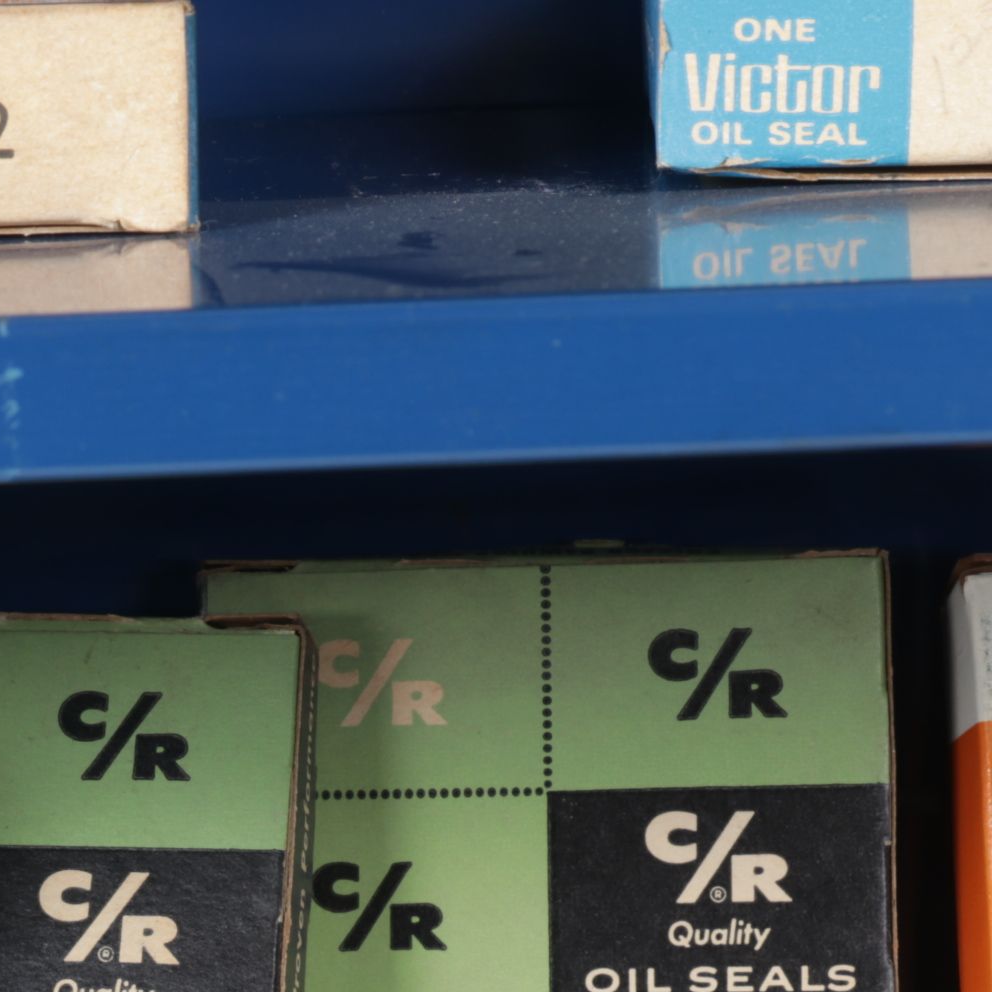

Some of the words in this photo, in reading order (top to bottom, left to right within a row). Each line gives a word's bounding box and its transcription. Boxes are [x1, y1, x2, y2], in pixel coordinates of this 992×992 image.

[734, 18, 816, 42] ONE
[684, 53, 881, 114] Victor
[691, 121, 753, 146] OIL
[768, 121, 868, 147] SEAL
[647, 627, 789, 722] C/R
[57, 690, 192, 782] C/R
[312, 860, 448, 952] C/R
[667, 919, 772, 952] Quality
